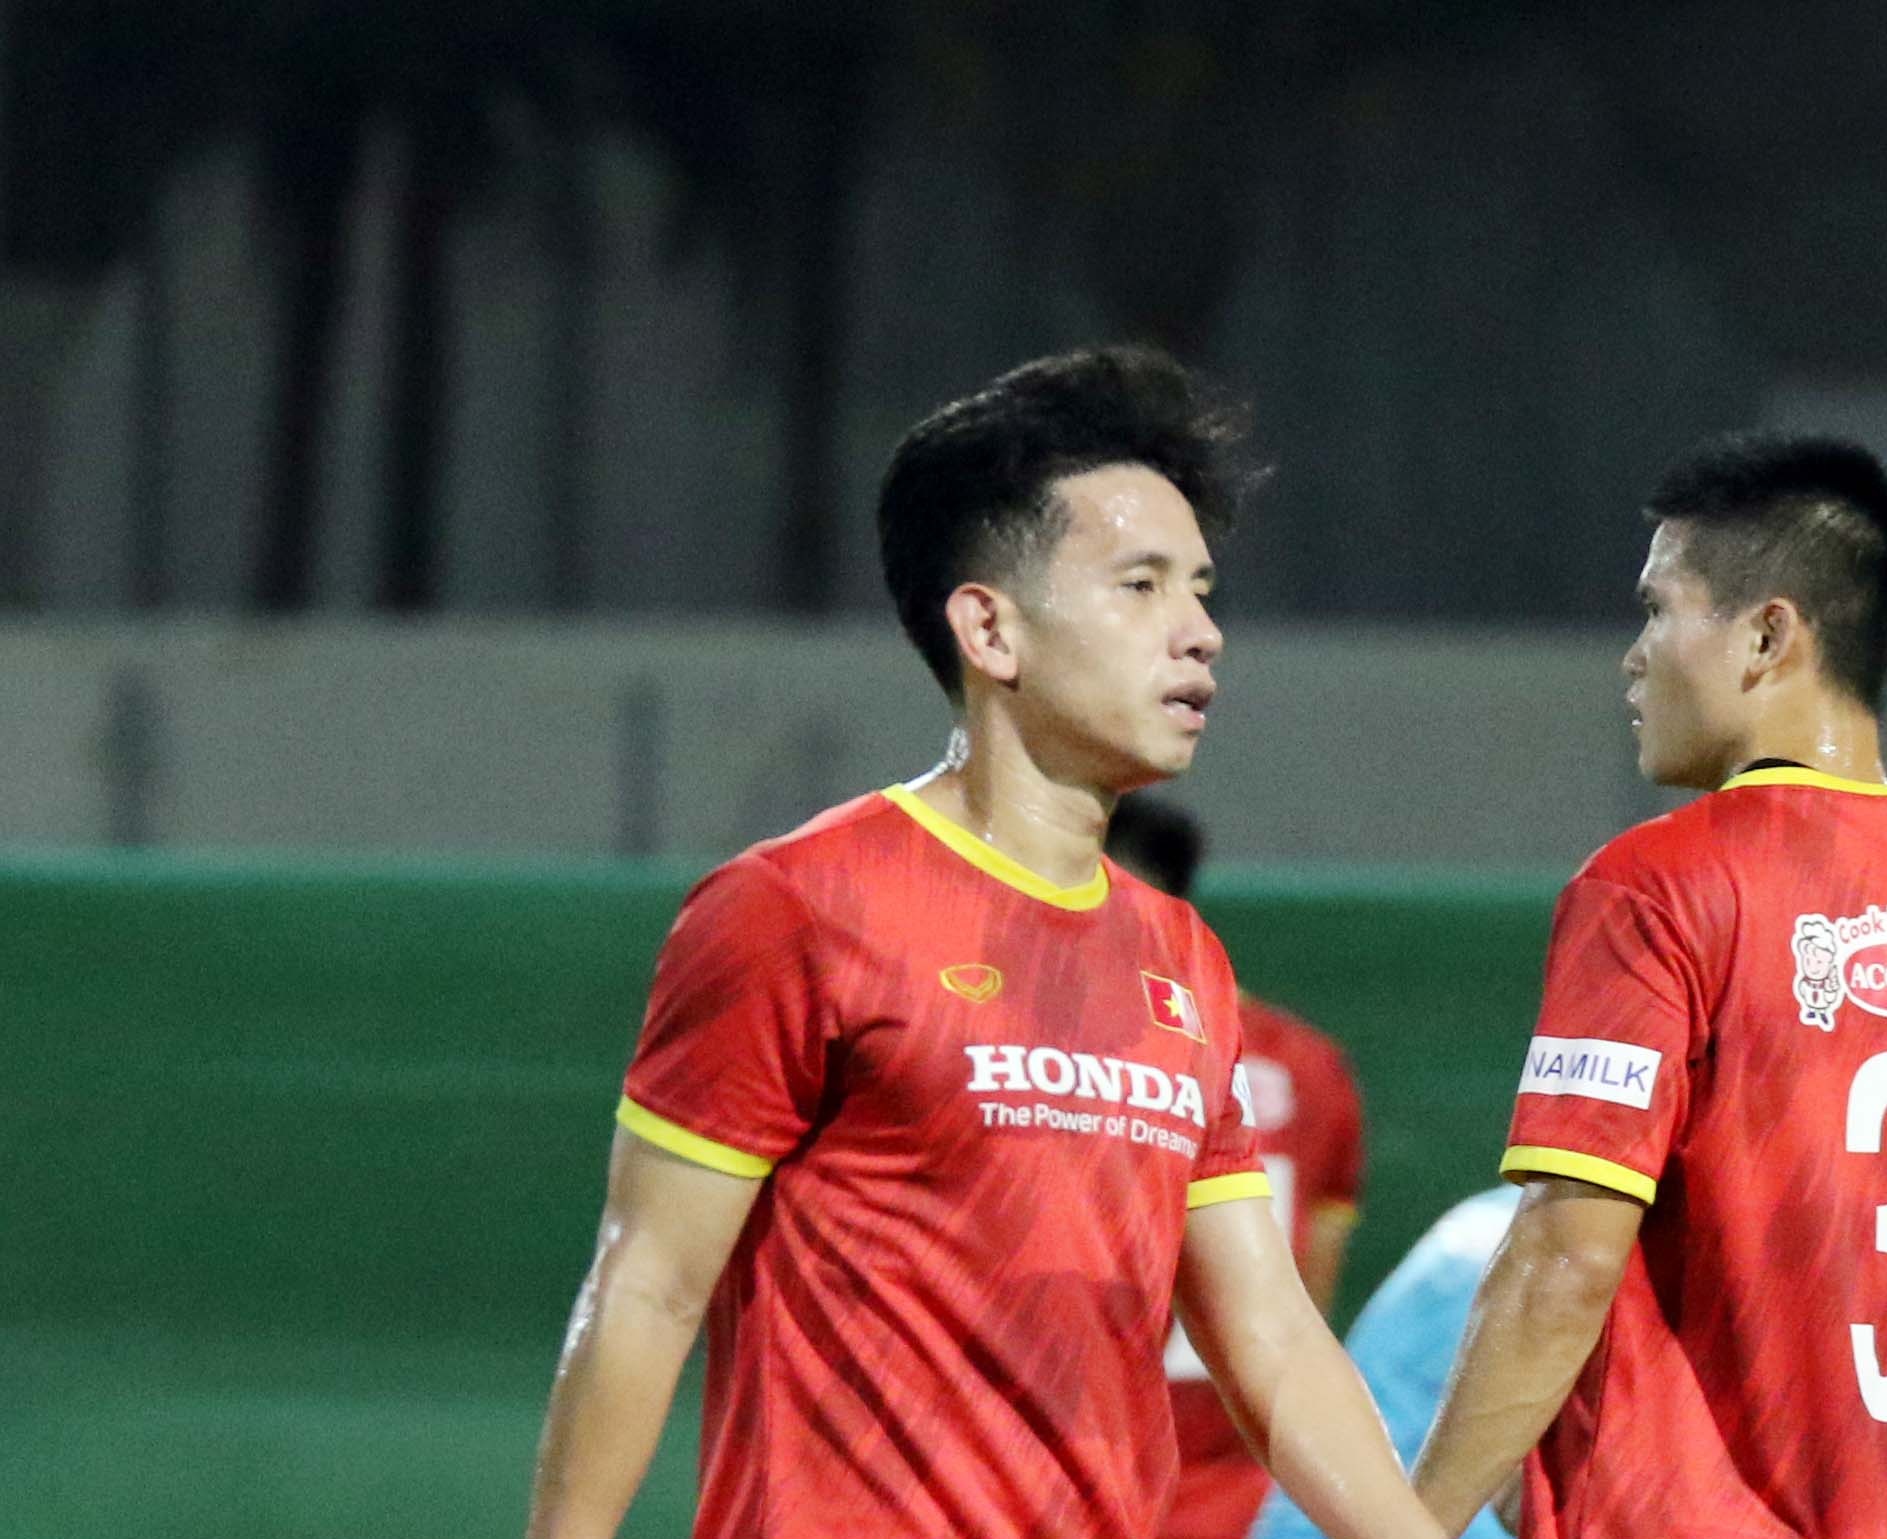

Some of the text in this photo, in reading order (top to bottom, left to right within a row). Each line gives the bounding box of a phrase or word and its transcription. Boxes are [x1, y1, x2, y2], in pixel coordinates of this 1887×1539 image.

[1838, 910, 1884, 945] Cook
[964, 1045, 1206, 1128] HONDA
[978, 1102, 1031, 1128] The
[1034, 1103, 1101, 1134] Power
[1105, 1115, 1128, 1138] of
